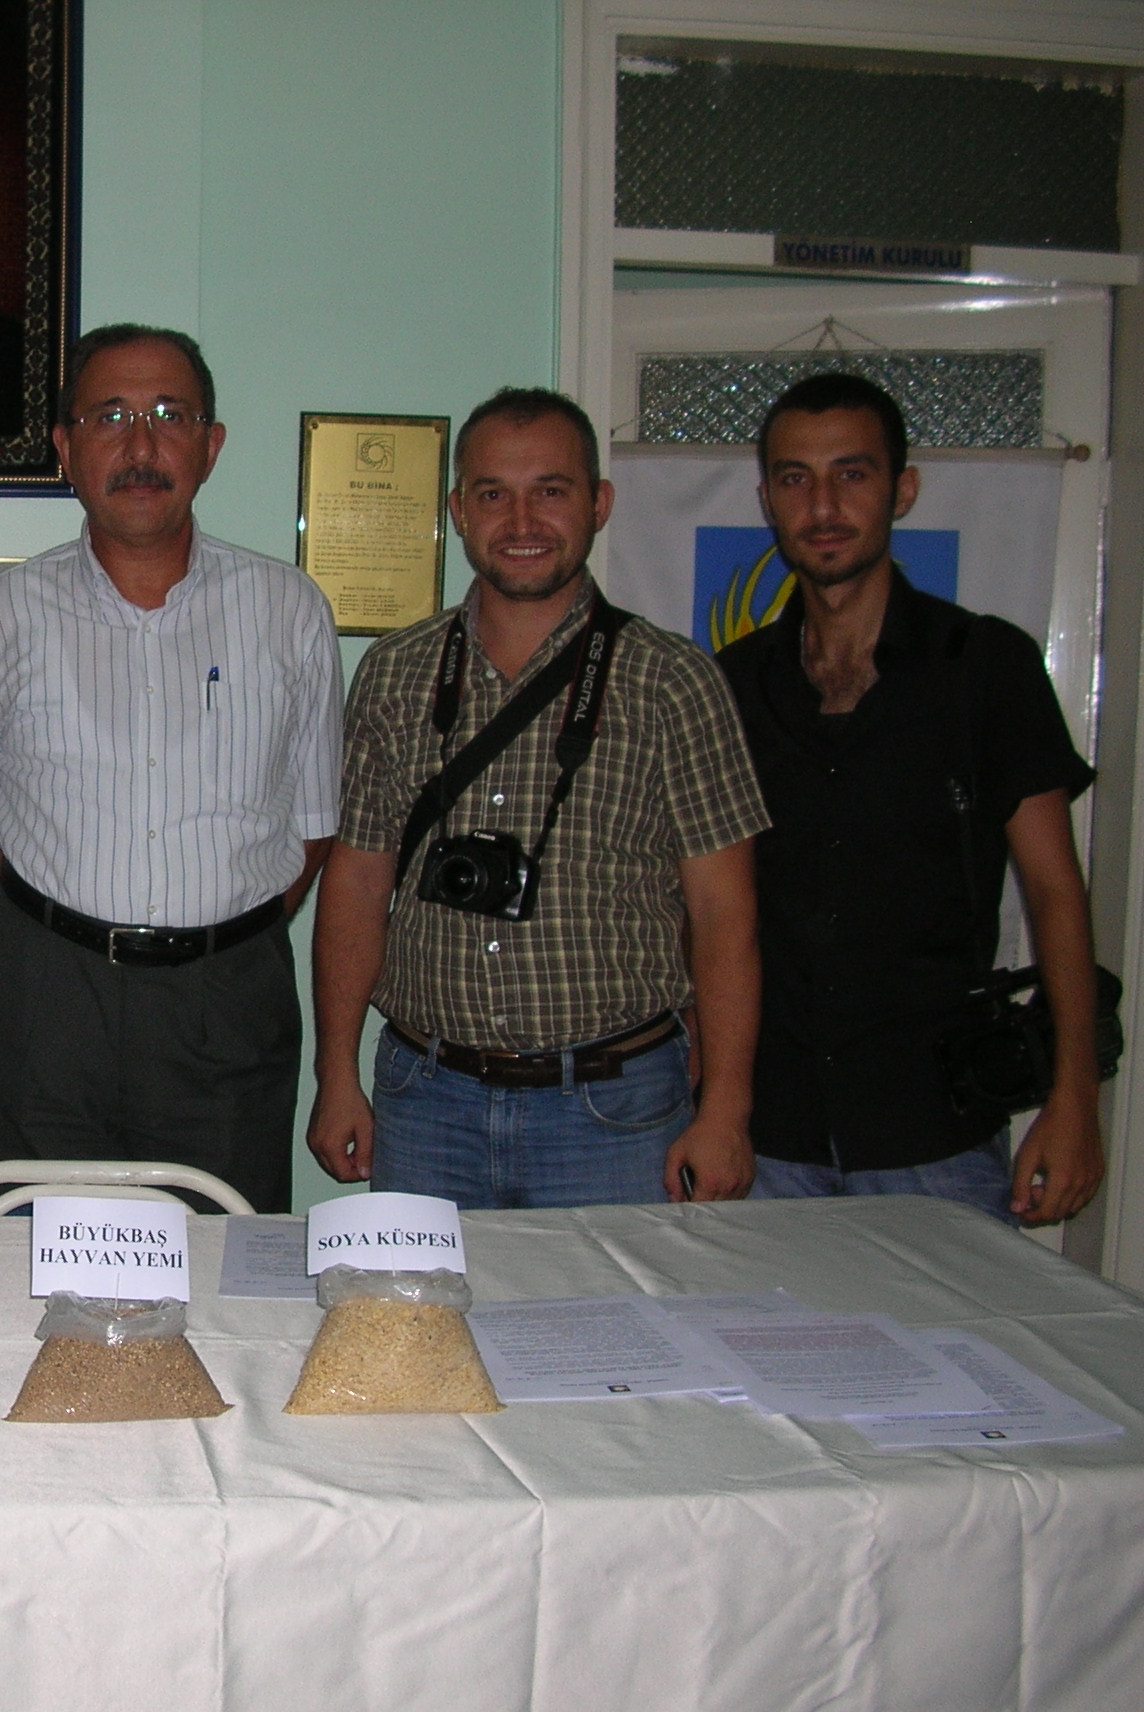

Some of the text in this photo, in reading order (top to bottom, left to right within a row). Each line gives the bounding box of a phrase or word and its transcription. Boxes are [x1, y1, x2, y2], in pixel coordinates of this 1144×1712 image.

[783, 238, 962, 268] YÖNETİM KURULU
[574, 631, 605, 722] EOS DIGITAL
[59, 1222, 168, 1248] BÜYÜKBAŞ
[318, 1228, 457, 1252] SOYA KÜSPESİ
[39, 1247, 184, 1269] HAYVAN YEMİ
